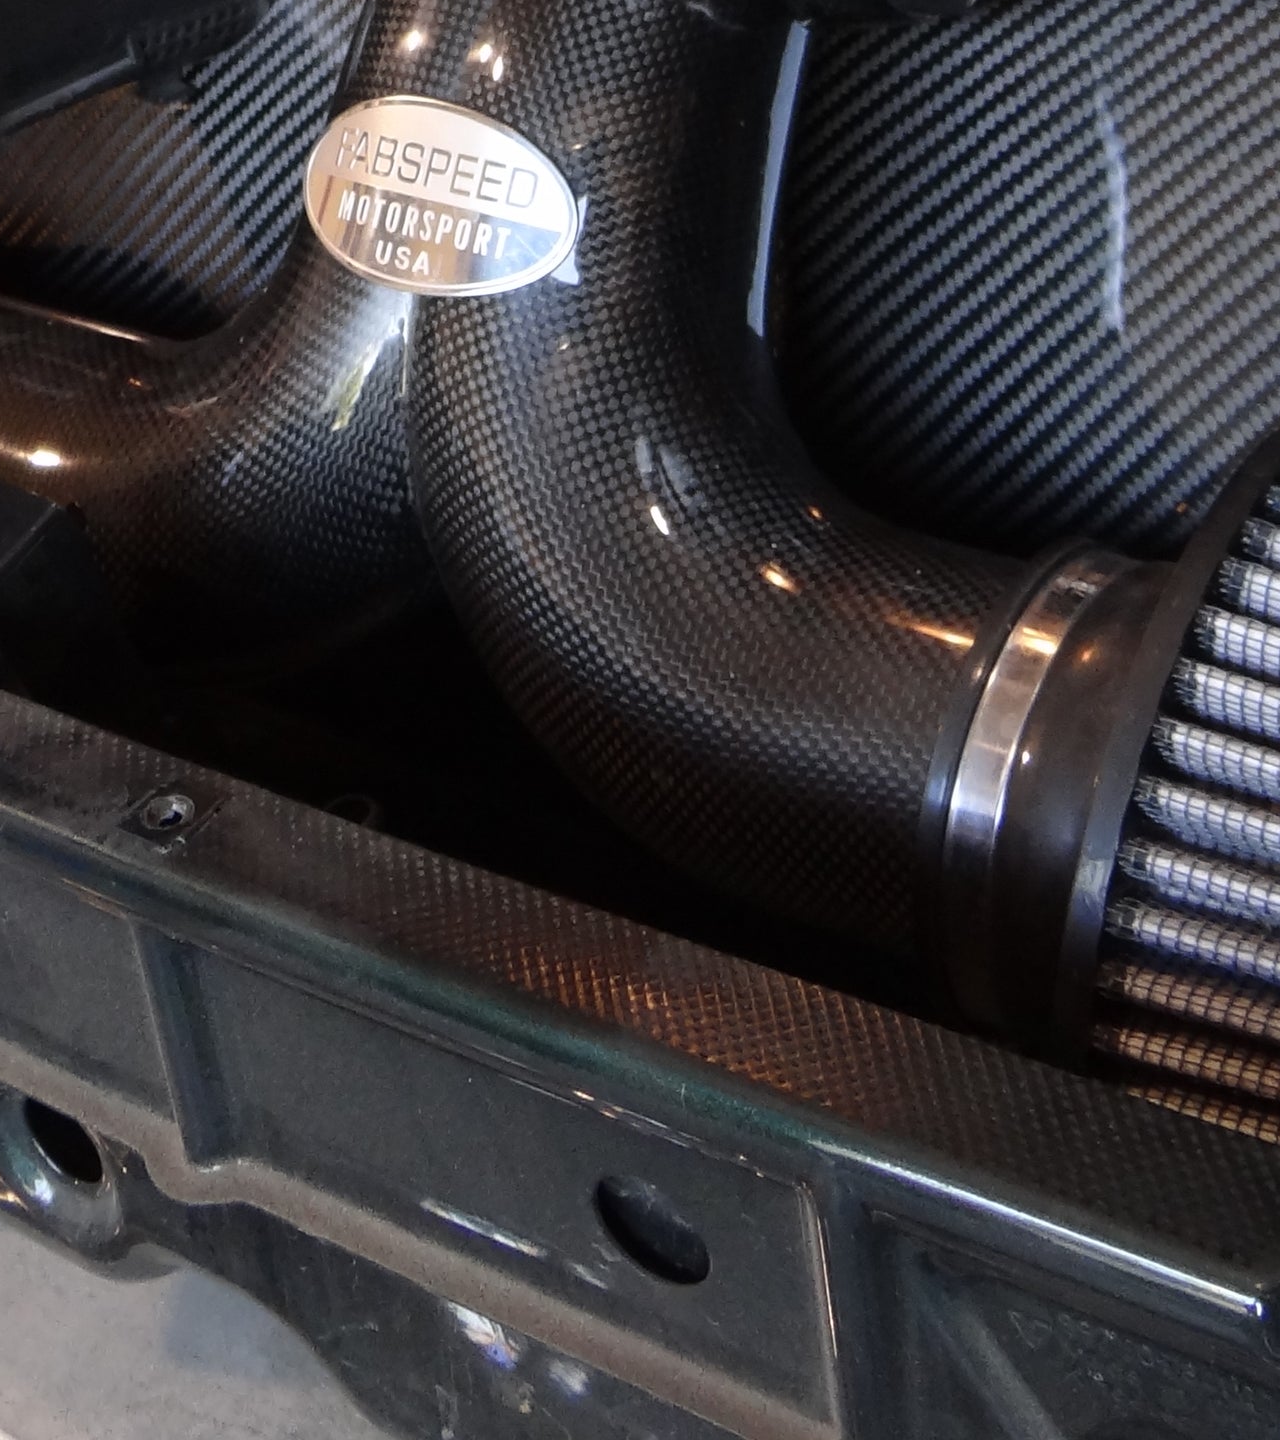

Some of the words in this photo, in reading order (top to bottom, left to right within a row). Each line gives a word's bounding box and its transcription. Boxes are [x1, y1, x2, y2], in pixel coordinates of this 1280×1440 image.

[336, 127, 539, 209] FABSPEED
[337, 189, 513, 260] MOTORSPORT
[374, 239, 431, 276] USA
